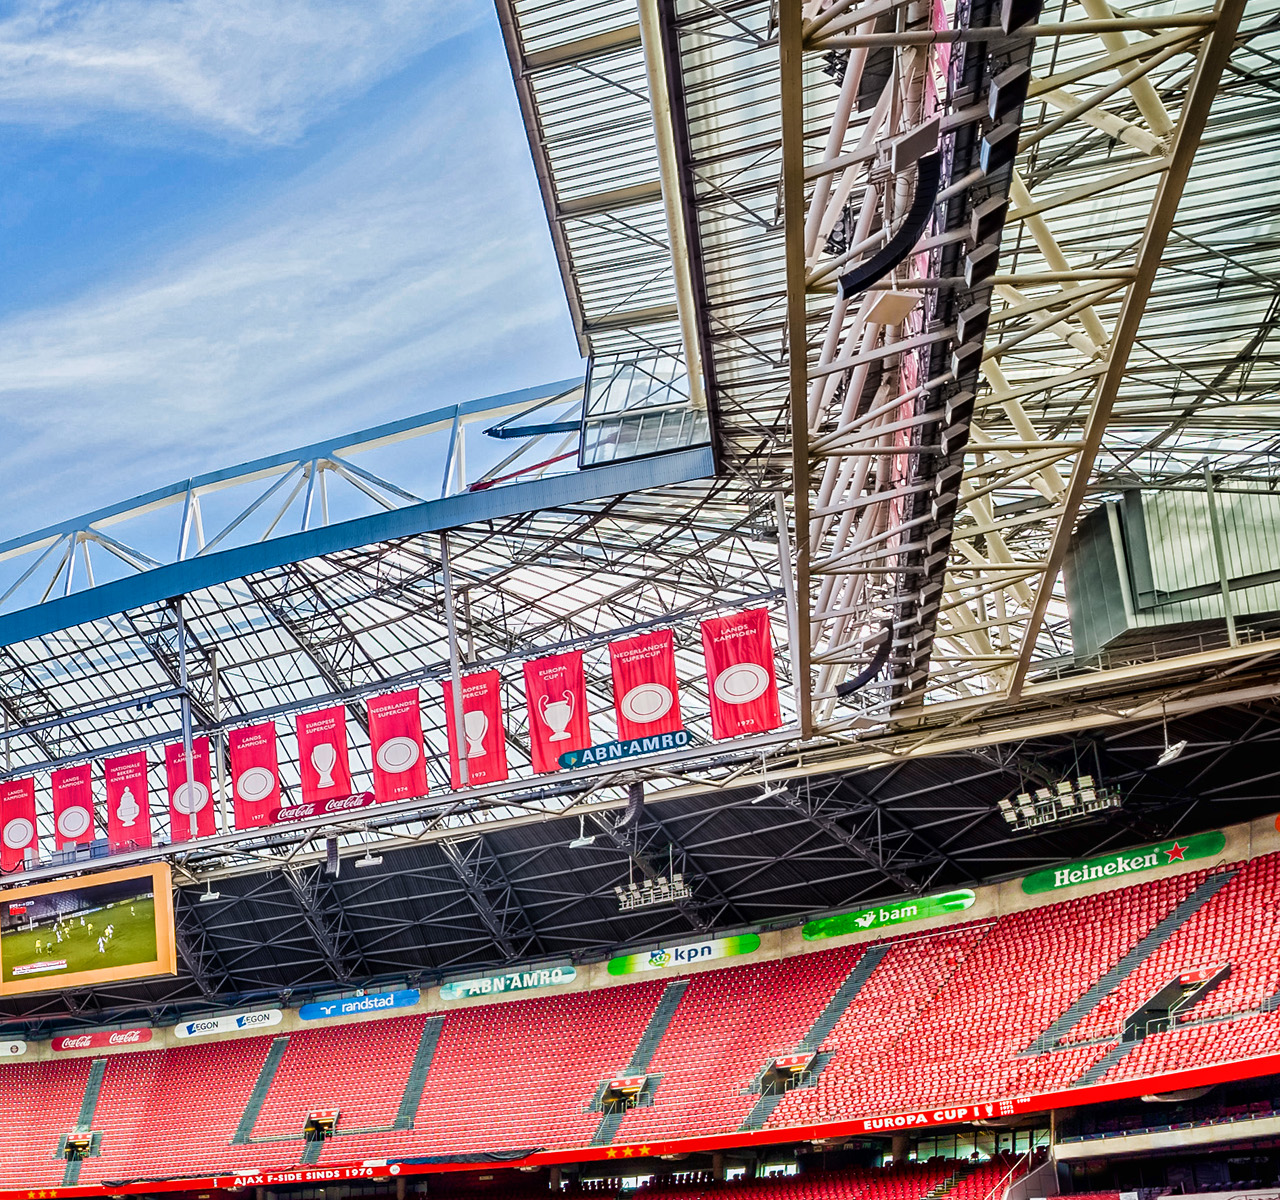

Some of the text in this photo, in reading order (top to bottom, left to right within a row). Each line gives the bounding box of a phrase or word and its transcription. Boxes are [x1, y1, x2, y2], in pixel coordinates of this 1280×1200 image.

[713, 628, 757, 643] KAMPIOEN
[720, 623, 749, 636] LANDS
[613, 642, 669, 659] NEDERLANDSE
[621, 650, 661, 663] SUPERCUP
[538, 665, 567, 676] EUROPA
[543, 673, 559, 681] CUP
[370, 699, 416, 714] NEDERLANDSE
[377, 706, 410, 718] SUPERCUP
[305, 718, 335, 729] EUROPESE
[305, 723, 336, 735] SUPERCUP
[737, 719, 755, 727] 1973
[237, 739, 267, 750] KAMPIOEN
[241, 734, 262, 743] LANDS
[110, 762, 141, 773] NATIONALE
[62, 776, 80, 784] LANDS
[110, 771, 142, 783] KNVB BEKER
[471, 771, 486, 779] 1973
[58, 780, 85, 789] KAMPIOEN
[3, 792, 28, 802] KAMPIOEN
[7, 788, 23, 796] LANDS
[1054, 851, 1159, 888] Heineken
[879, 904, 917, 922] bam
[674, 943, 712, 964] kpn
[341, 993, 394, 1013] randstad
[238, 1013, 270, 1026] AEGON
[191, 1020, 219, 1033] AEGON
[863, 1107, 980, 1130] EUROPA CUP I
[234, 1167, 373, 1186] AJAX F-SIDE SINDS 1976
